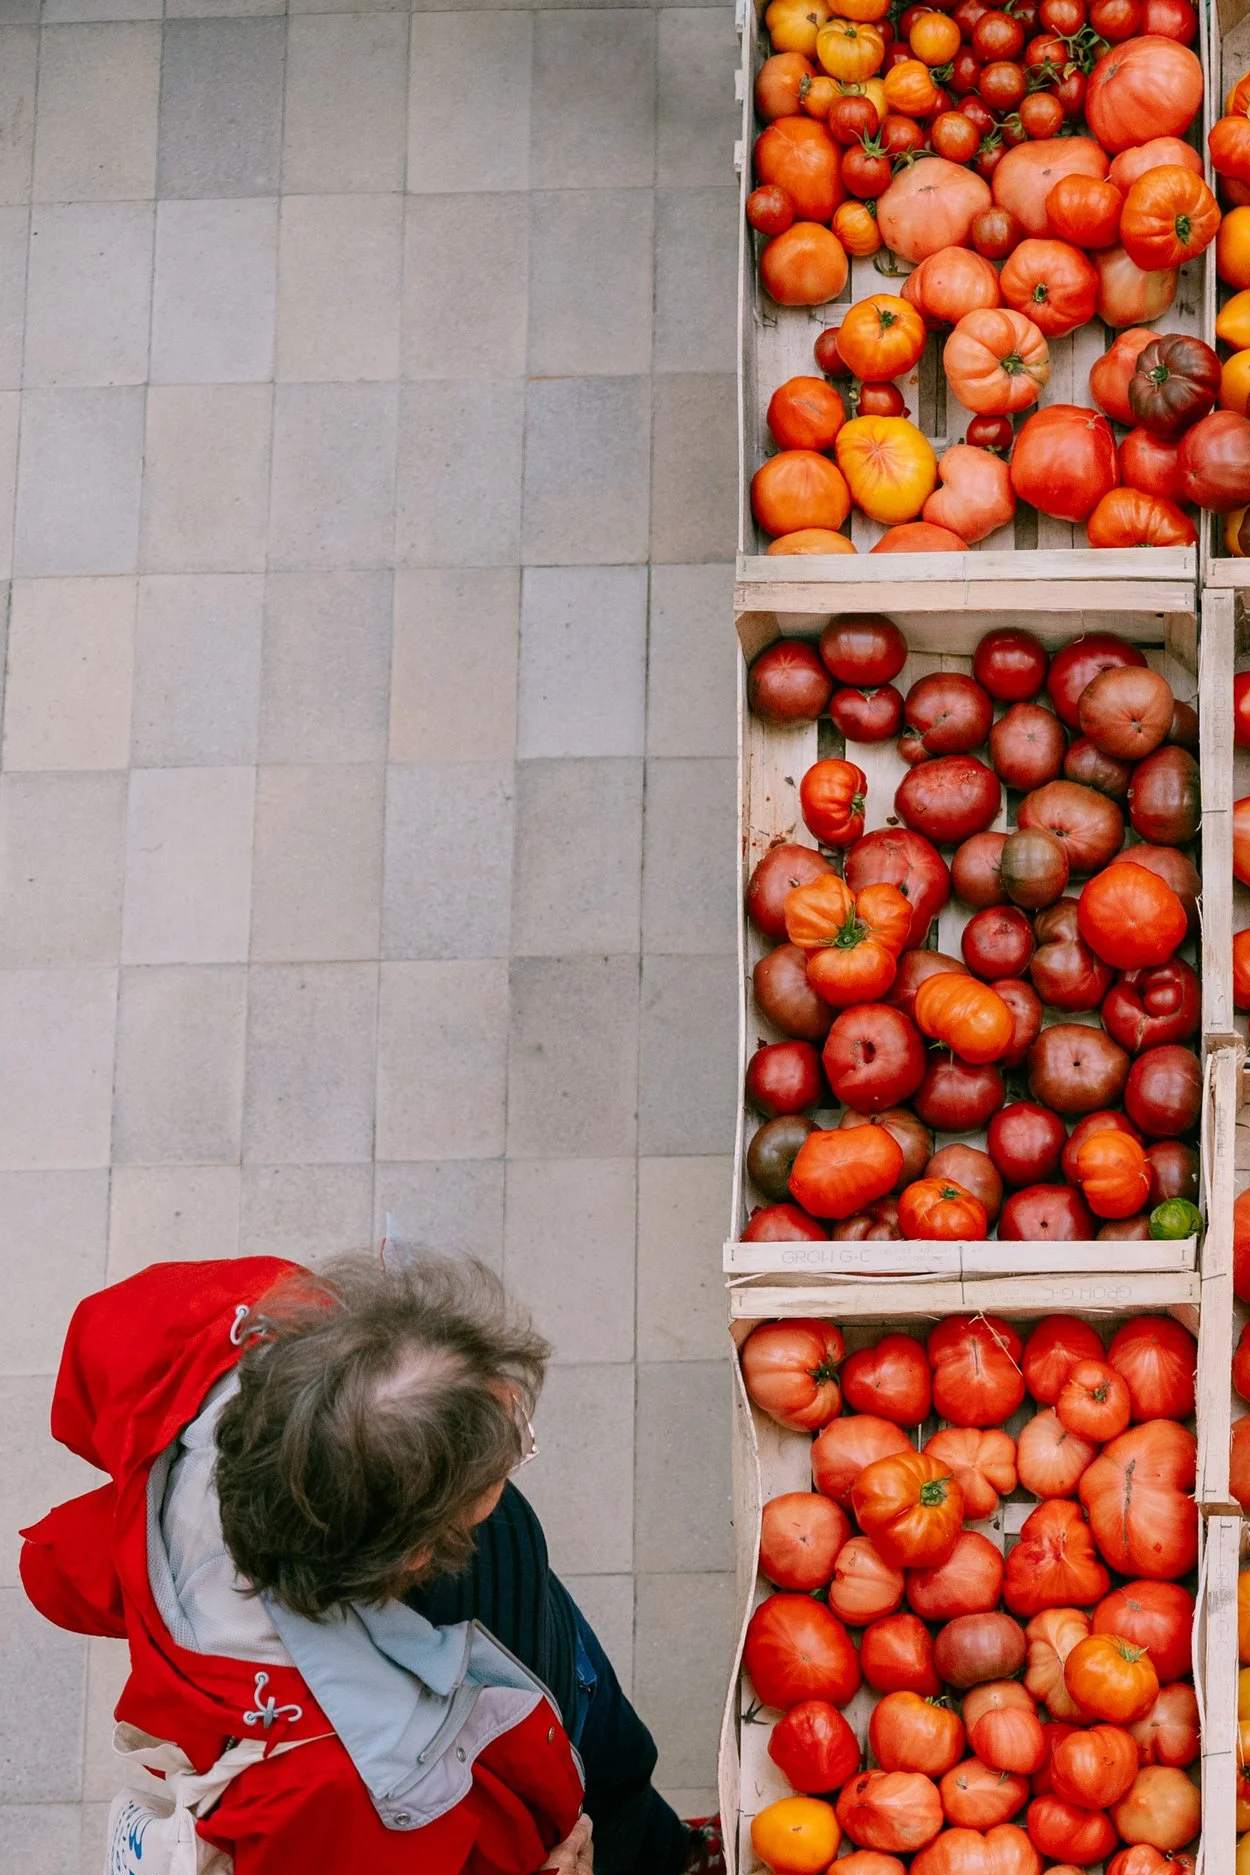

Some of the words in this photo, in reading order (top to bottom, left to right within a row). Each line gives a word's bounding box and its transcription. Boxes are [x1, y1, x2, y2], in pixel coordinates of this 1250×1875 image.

[781, 1249, 834, 1264] GROW
[839, 1249, 871, 1263] G-C
[1080, 1285, 1132, 1300] GROW
